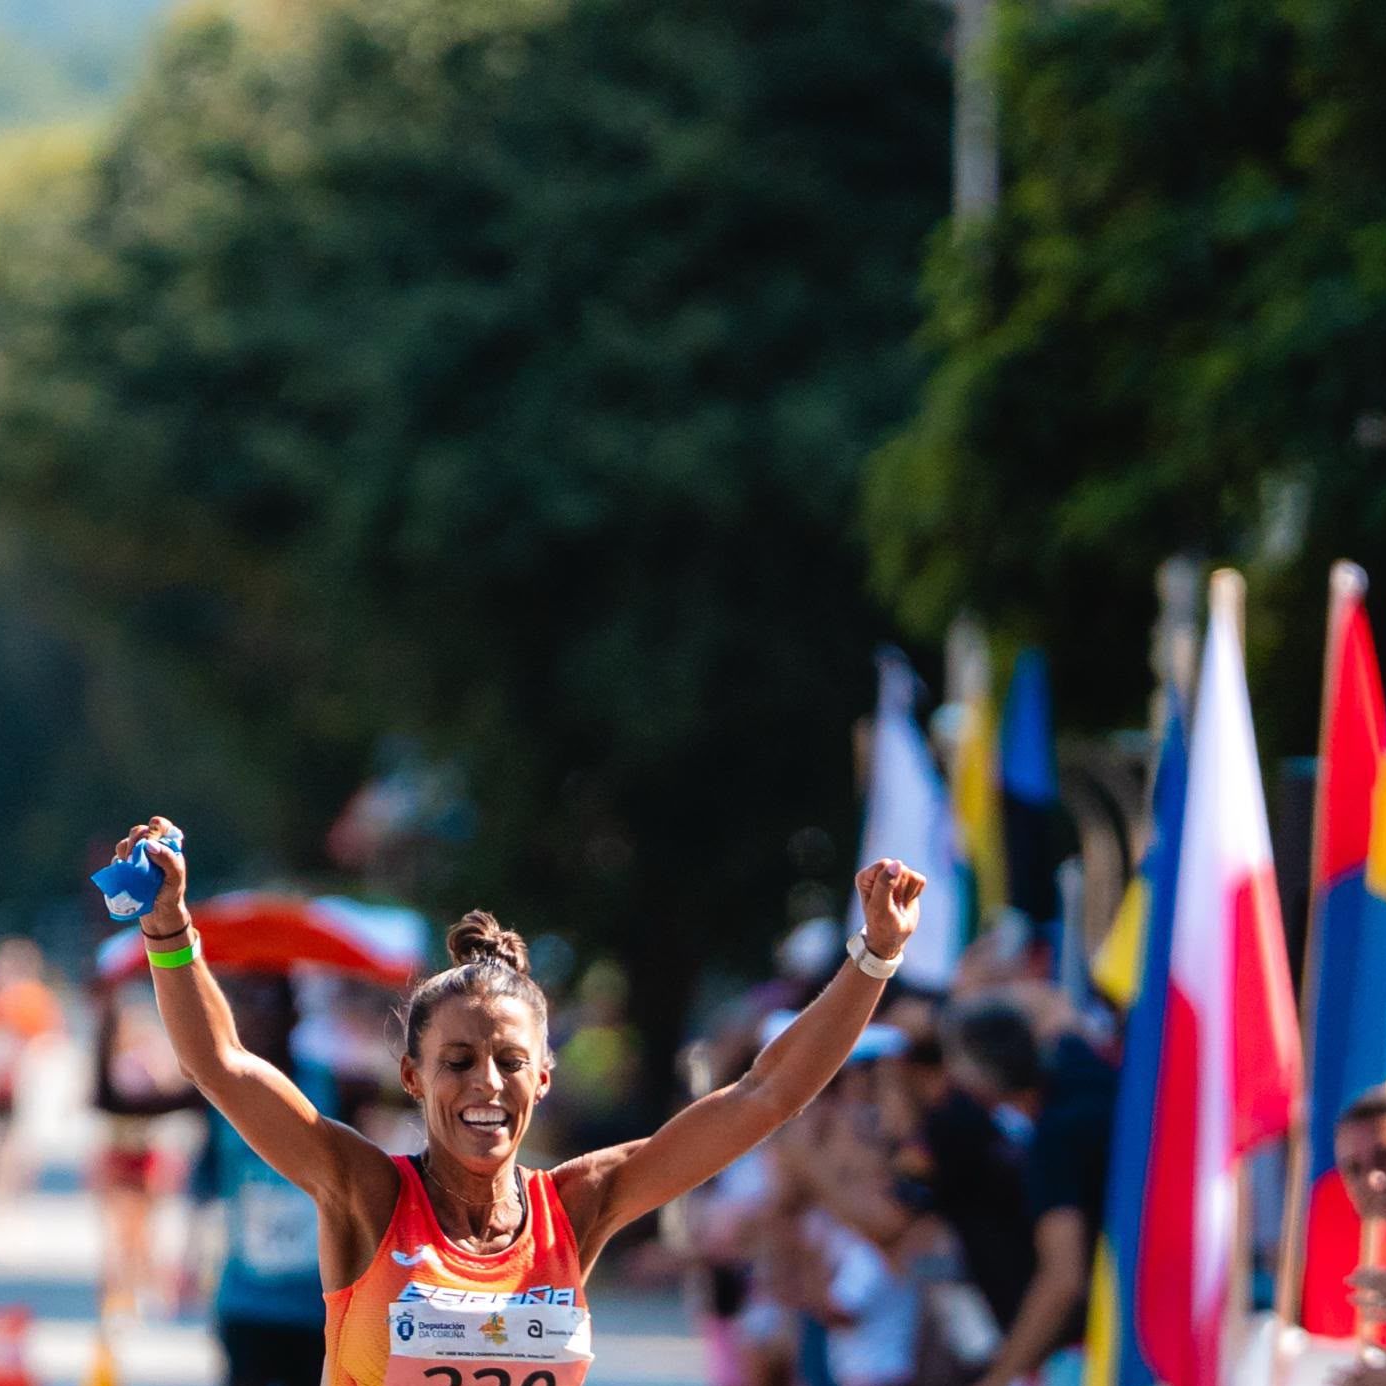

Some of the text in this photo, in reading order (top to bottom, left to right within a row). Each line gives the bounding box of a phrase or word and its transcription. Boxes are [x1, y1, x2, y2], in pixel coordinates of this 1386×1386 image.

[418, 1321, 465, 1331] Deputación
[418, 1330, 466, 1339] DA CORUÑA
